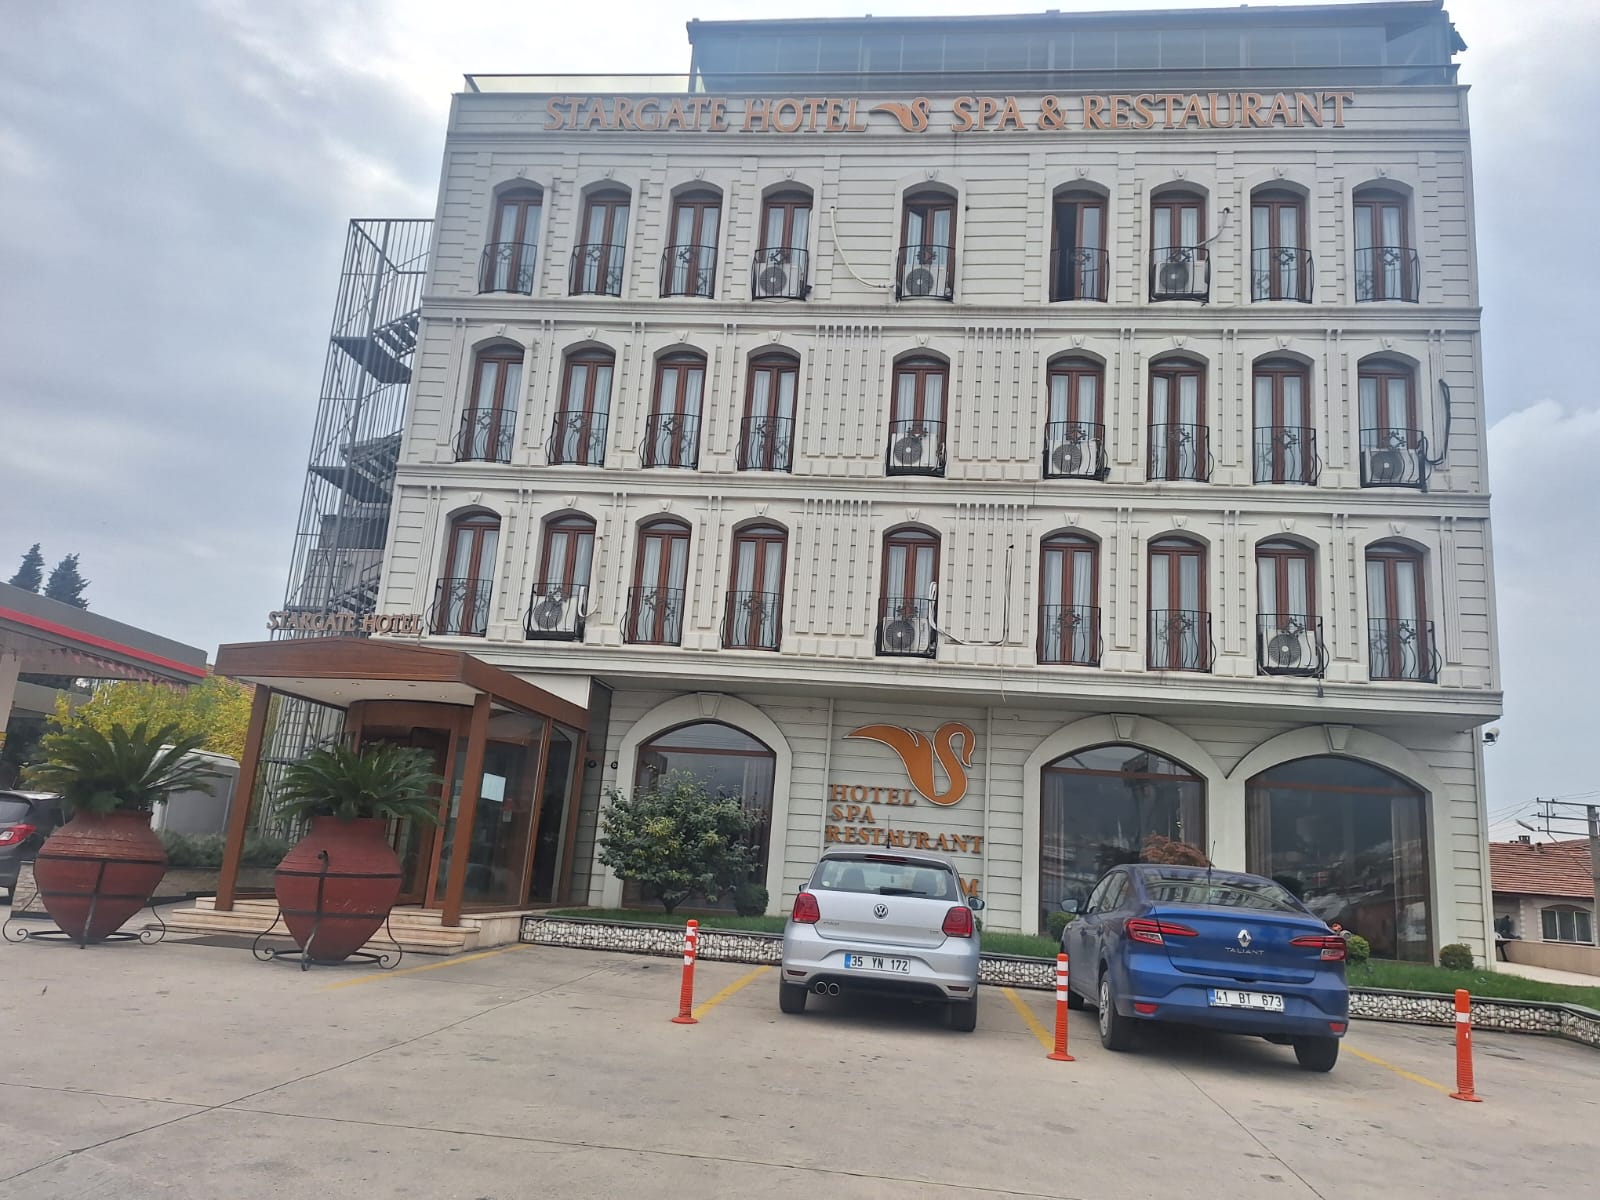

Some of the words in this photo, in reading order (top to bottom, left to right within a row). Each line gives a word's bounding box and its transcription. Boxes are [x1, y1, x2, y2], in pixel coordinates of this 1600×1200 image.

[543, 97, 728, 132] STARGATE
[740, 97, 868, 132] HOTEL
[951, 96, 1028, 132] SPA
[1037, 94, 1067, 131] &
[1082, 91, 1354, 130] RESTAURANT
[266, 610, 356, 632] STARGATE
[362, 613, 425, 634] HOTEL
[830, 783, 917, 806] HOTEL
[831, 804, 876, 823] SPA
[825, 824, 984, 854] RESTAURANT
[851, 955, 863, 967] 35
[872, 957, 884, 969] YN
[891, 959, 909, 972] 172
[1215, 990, 1228, 1002] 41
[1238, 992, 1251, 1005] BT
[1261, 994, 1282, 1008] 673
